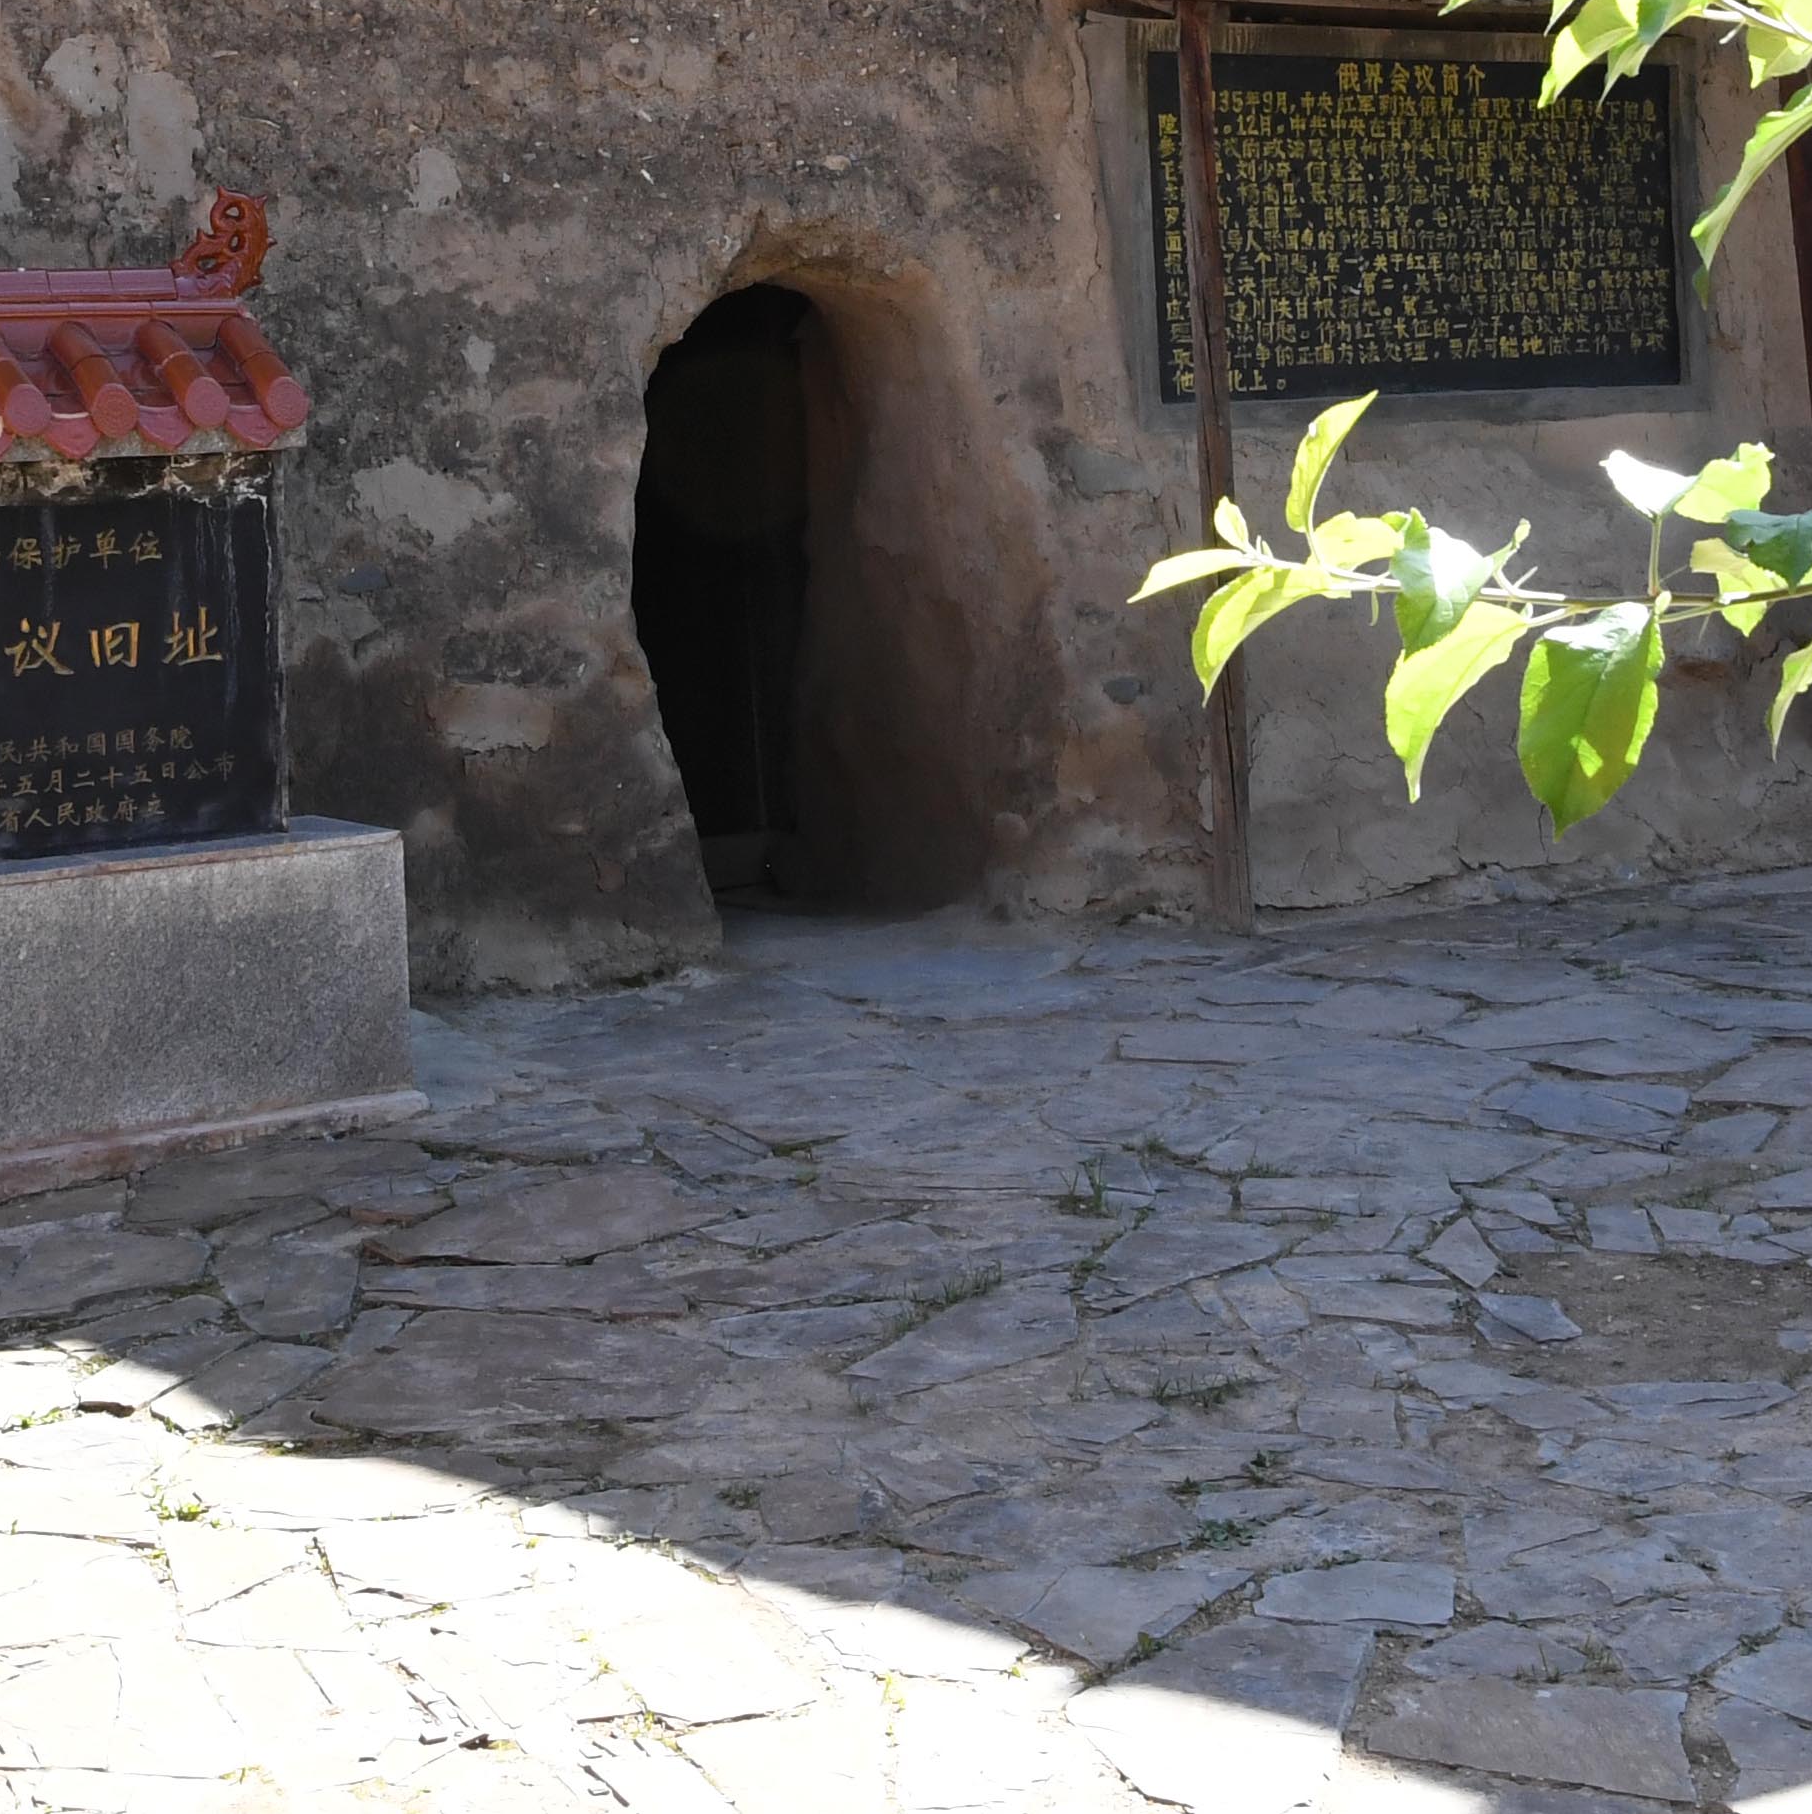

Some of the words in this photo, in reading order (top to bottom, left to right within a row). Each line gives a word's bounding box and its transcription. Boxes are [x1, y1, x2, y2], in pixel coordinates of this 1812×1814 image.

[1337, 61, 1486, 94] 俄界会议简介
